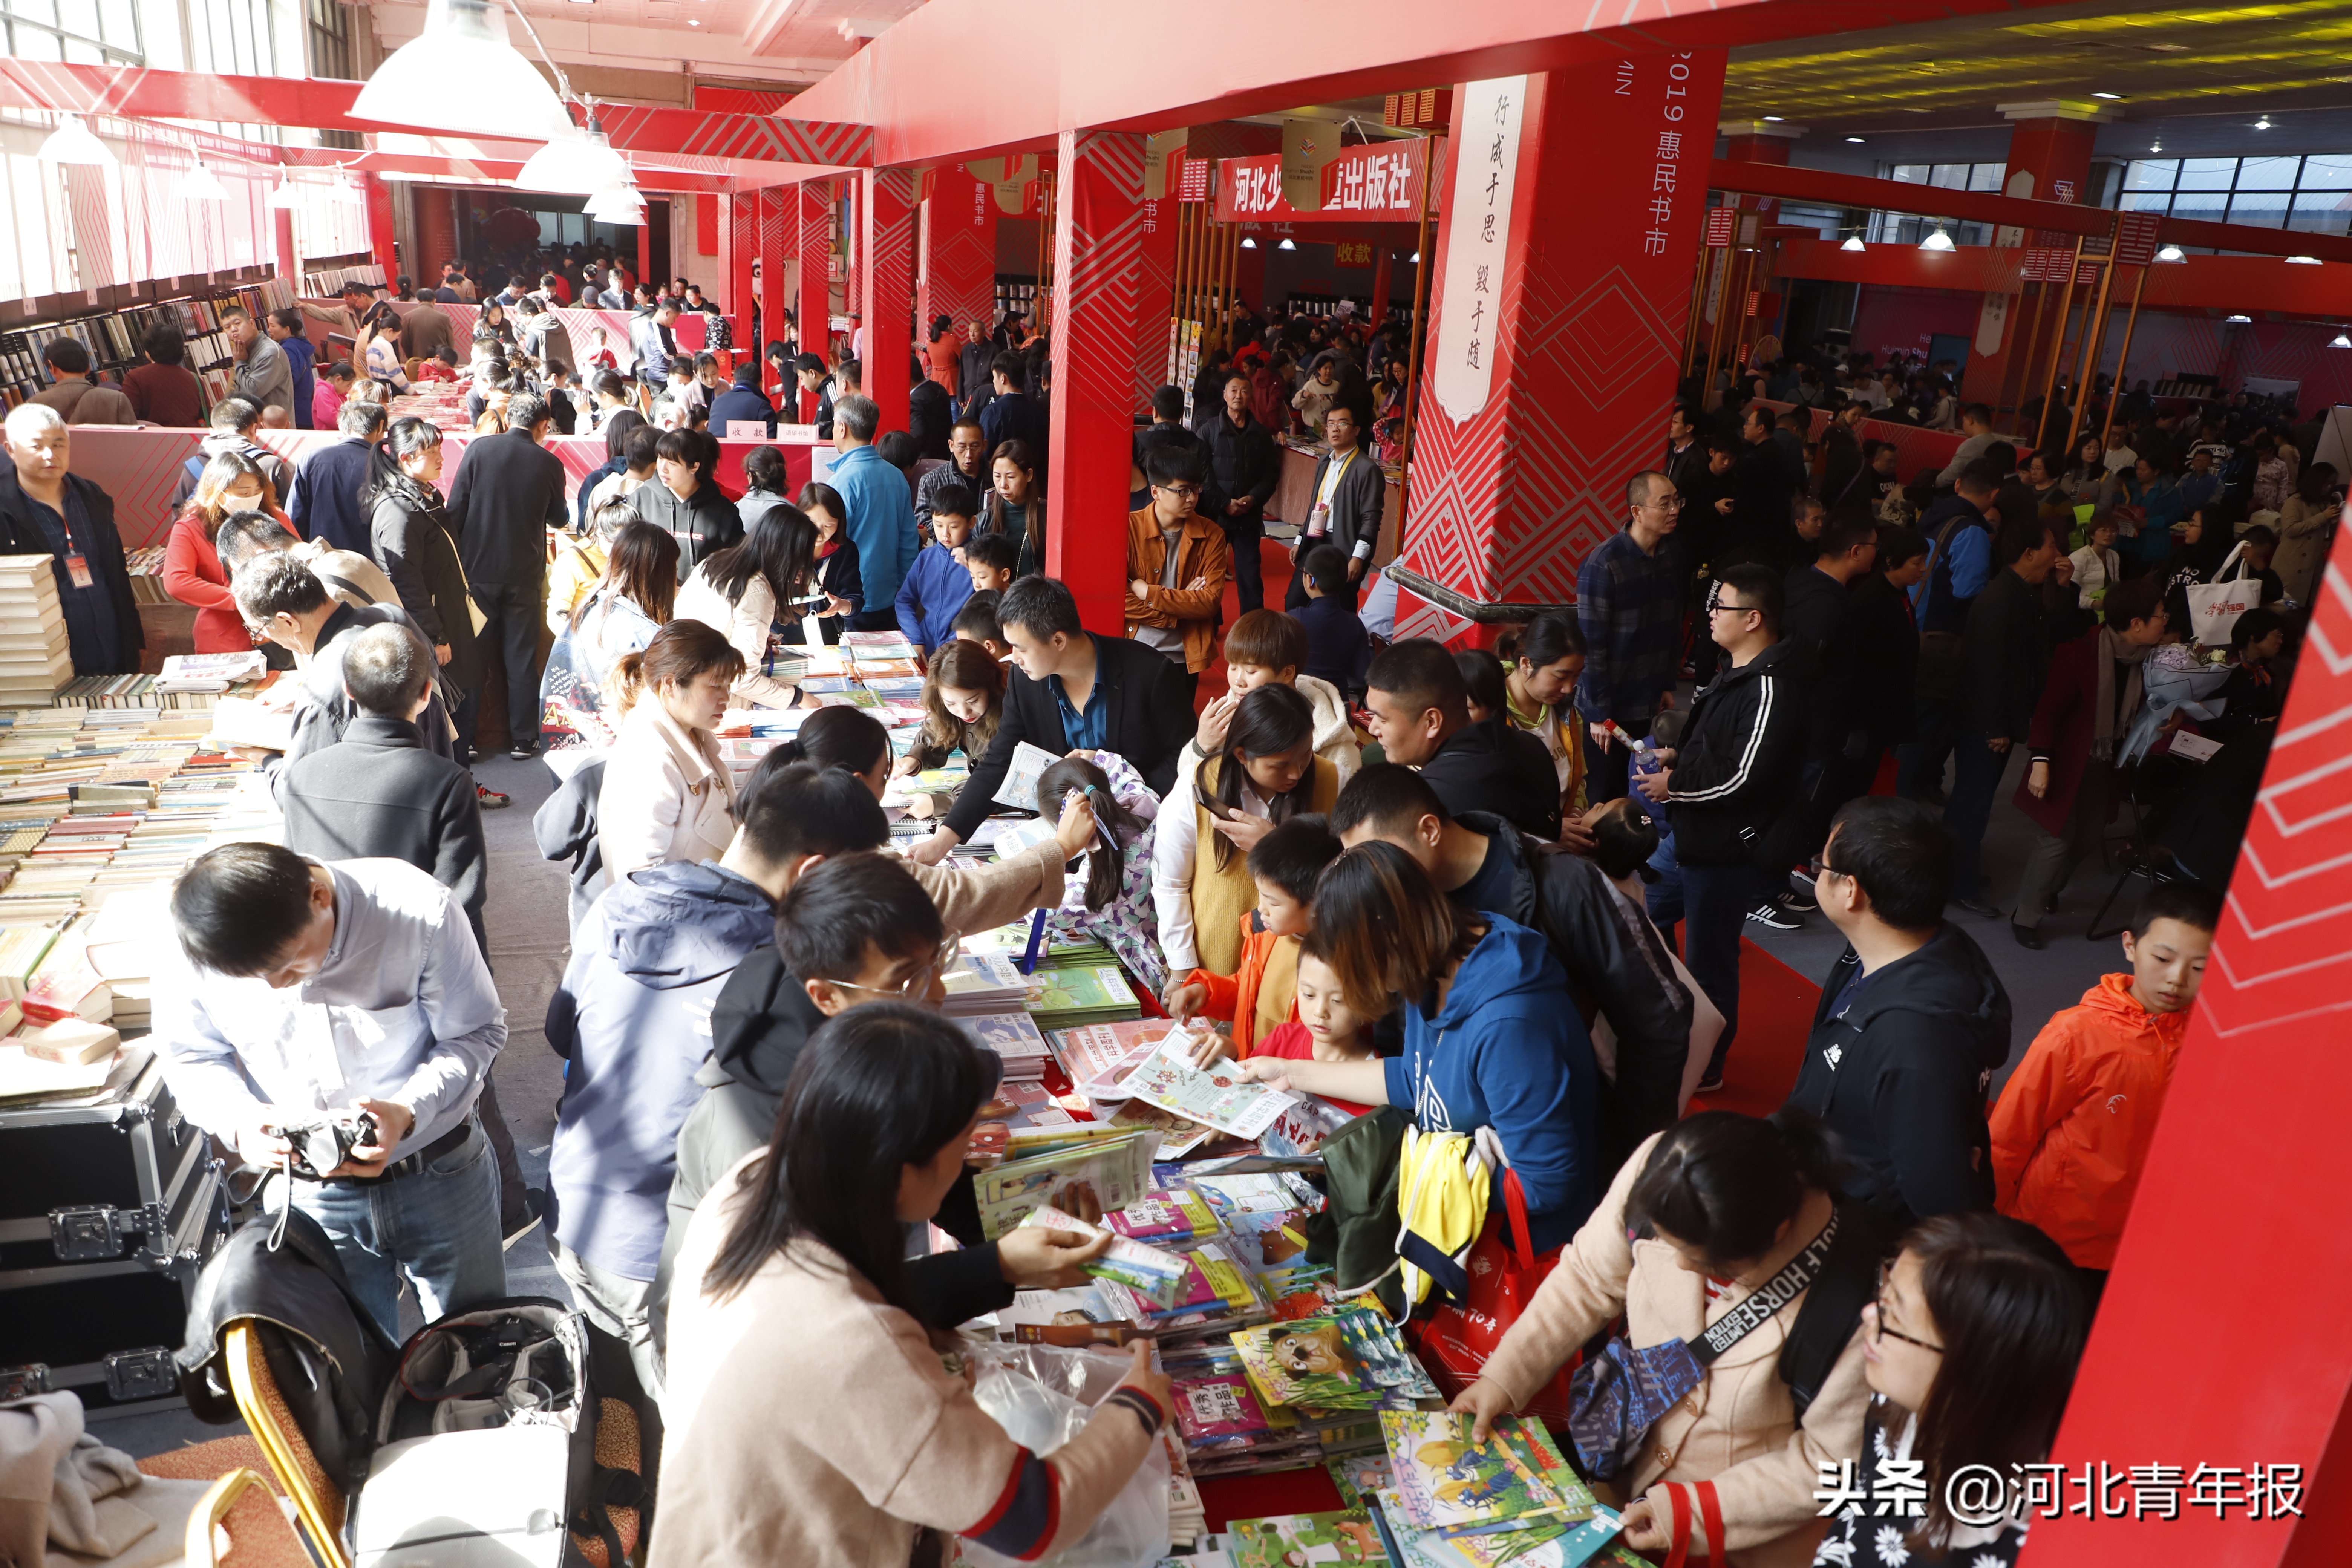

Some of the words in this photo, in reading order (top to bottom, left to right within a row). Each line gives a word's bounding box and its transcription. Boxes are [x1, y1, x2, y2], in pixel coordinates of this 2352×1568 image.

[1234, 152, 1411, 213] 河北少出版社
[1481, 94, 1510, 243] 行成于思
[974, 183, 985, 226] 惠民书市
[1645, 130, 1682, 257] 惠民书市
[1143, 198, 1158, 234] 书市
[1337, 243, 1371, 263] 收款
[732, 427, 764, 437] 收款
[2182, 565, 2200, 576] NO
[1101, 968, 1126, 998] 少儿科学周刊
[1302, 1101, 1319, 1117] GAP
[1736, 1262, 1811, 1329] HORSE
[1704, 1310, 1744, 1343] EDITION
[1712, 1321, 1750, 1353] LIMITED
[1395, 1439, 1436, 1524] 快乐作文
